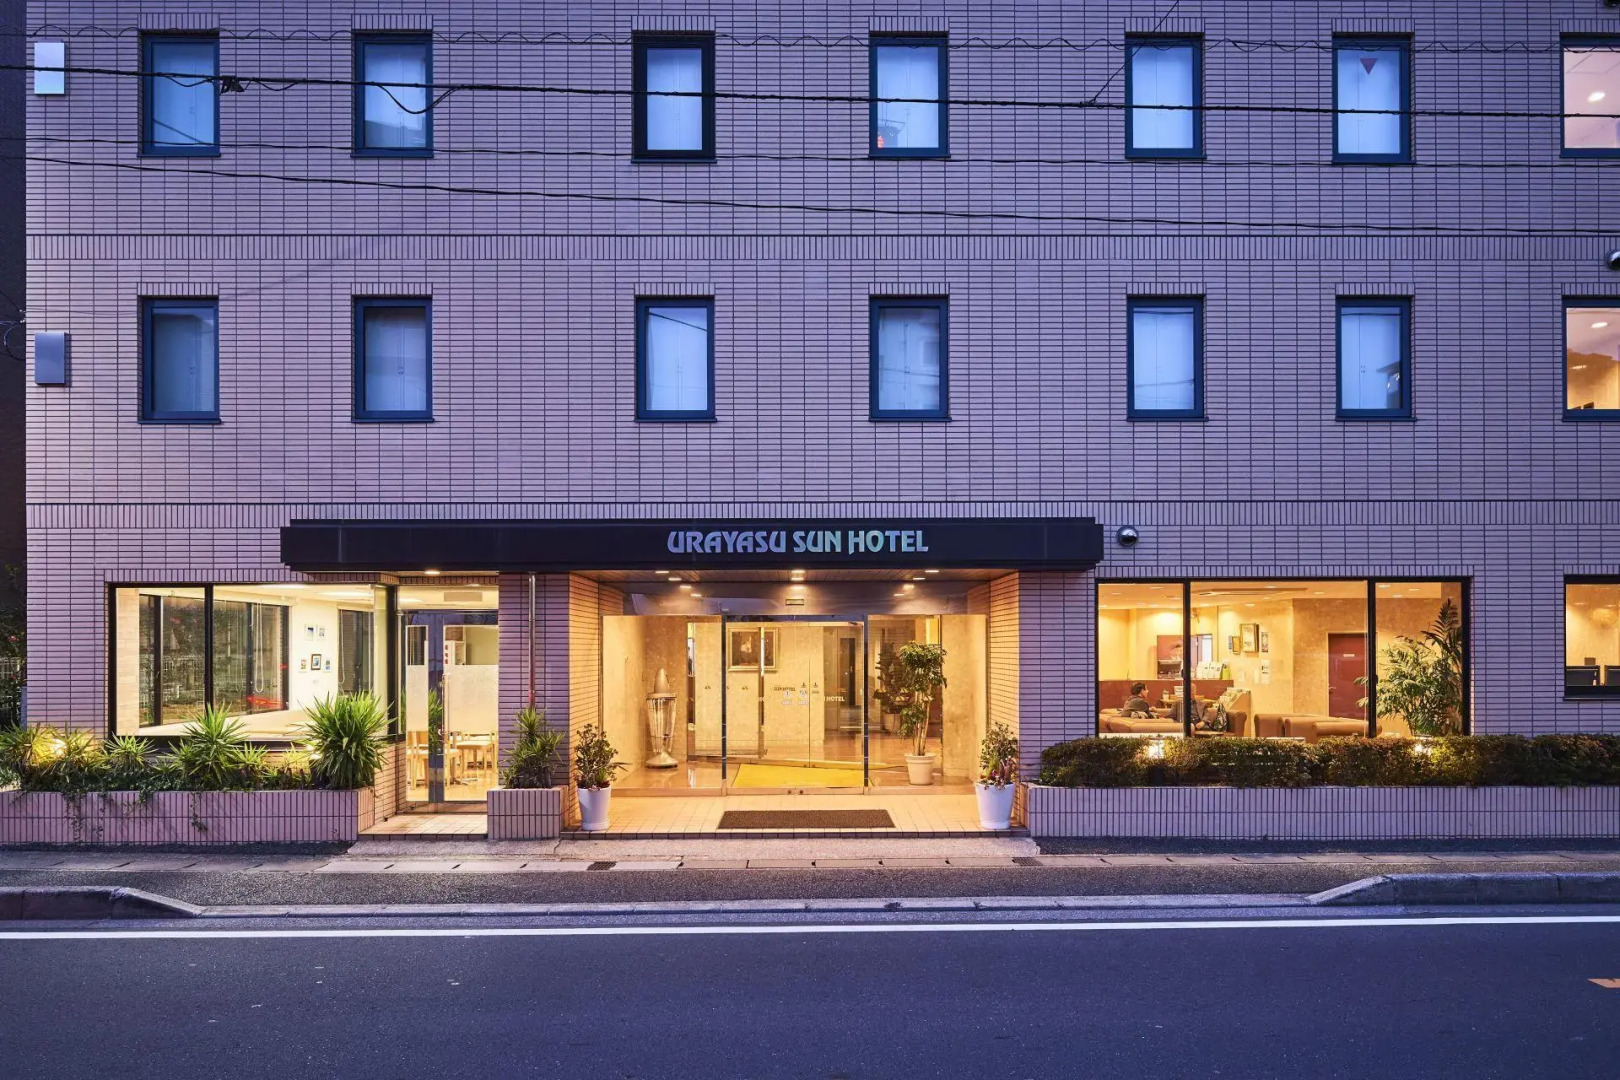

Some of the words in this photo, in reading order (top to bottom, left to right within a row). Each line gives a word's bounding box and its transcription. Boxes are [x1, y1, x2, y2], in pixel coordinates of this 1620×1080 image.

[667, 531, 786, 553] URAYASU
[793, 531, 841, 553] SUN
[848, 530, 929, 555] HOTEL
